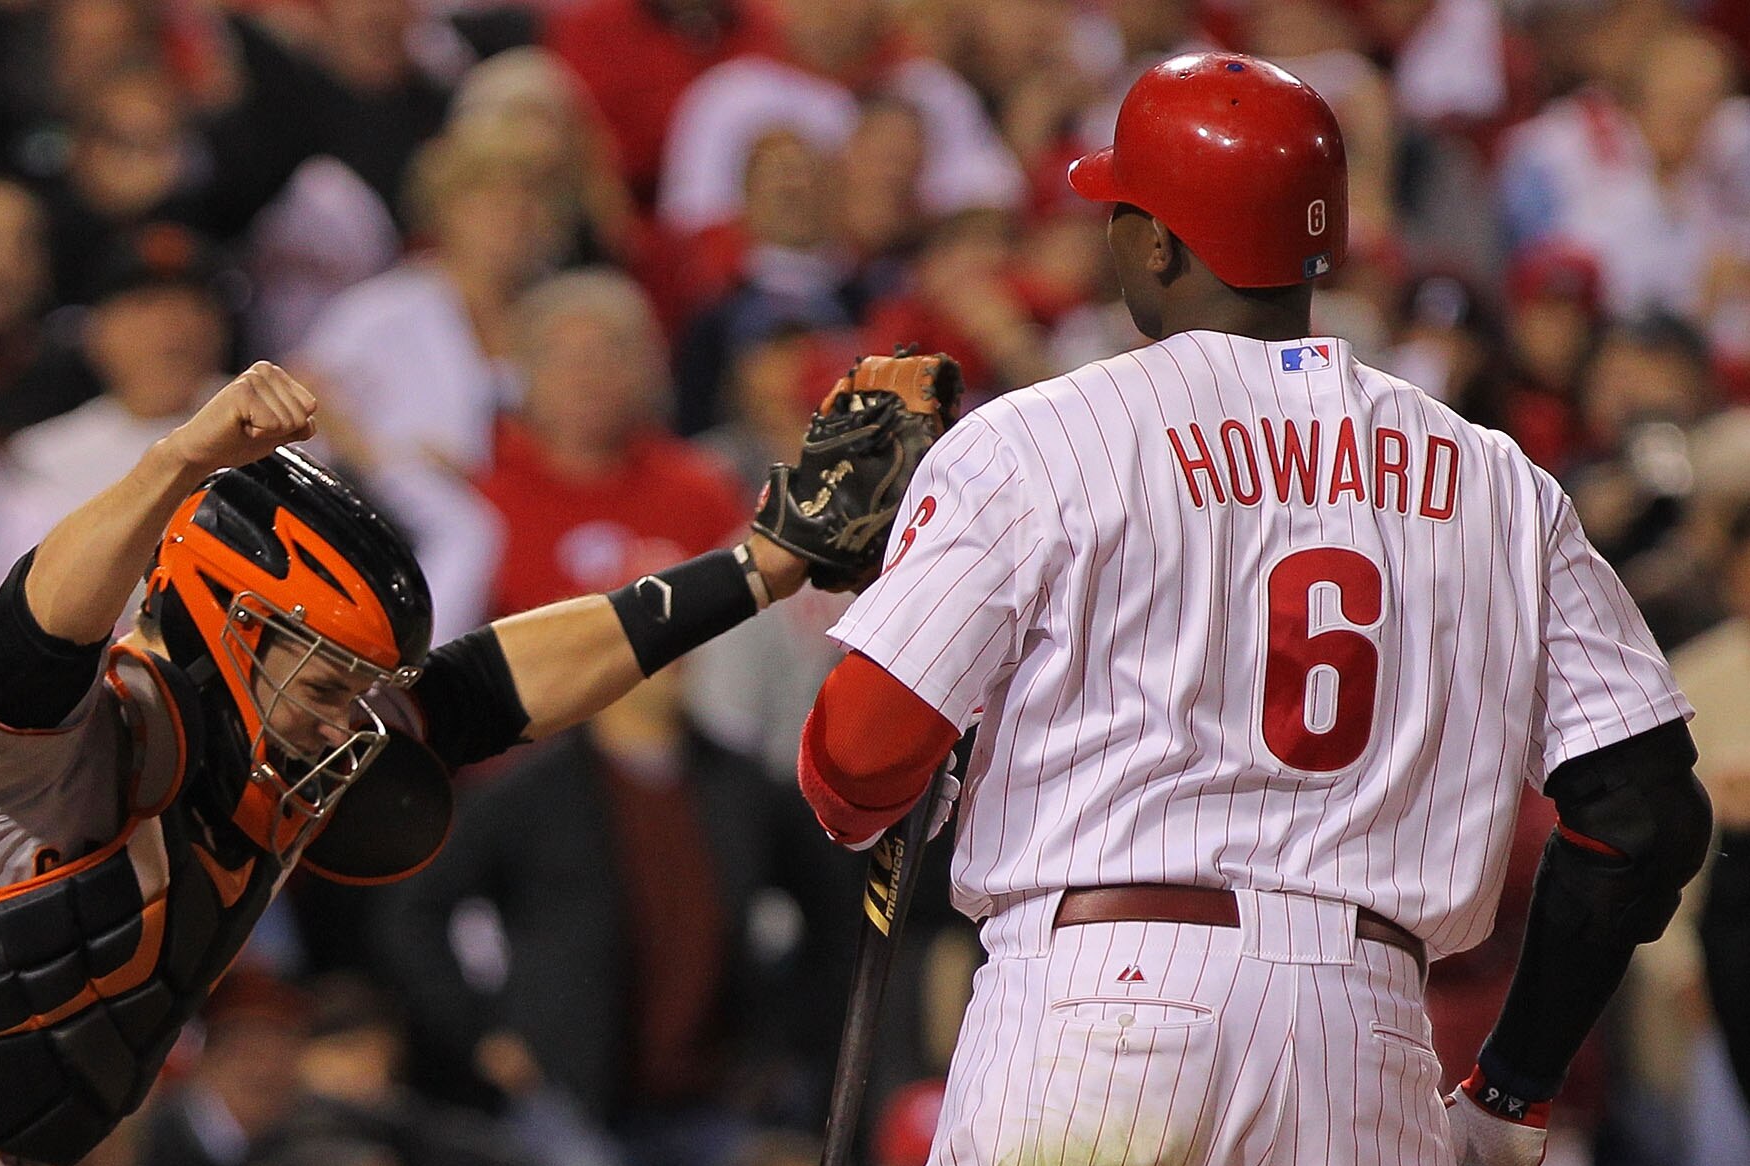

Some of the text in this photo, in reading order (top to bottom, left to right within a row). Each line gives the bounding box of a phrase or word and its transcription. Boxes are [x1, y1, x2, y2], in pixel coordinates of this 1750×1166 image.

[1307, 199, 1326, 236] 6
[1165, 416, 1461, 523] HOWARD
[1260, 546, 1384, 774] 6
[886, 837, 905, 920] marucci
